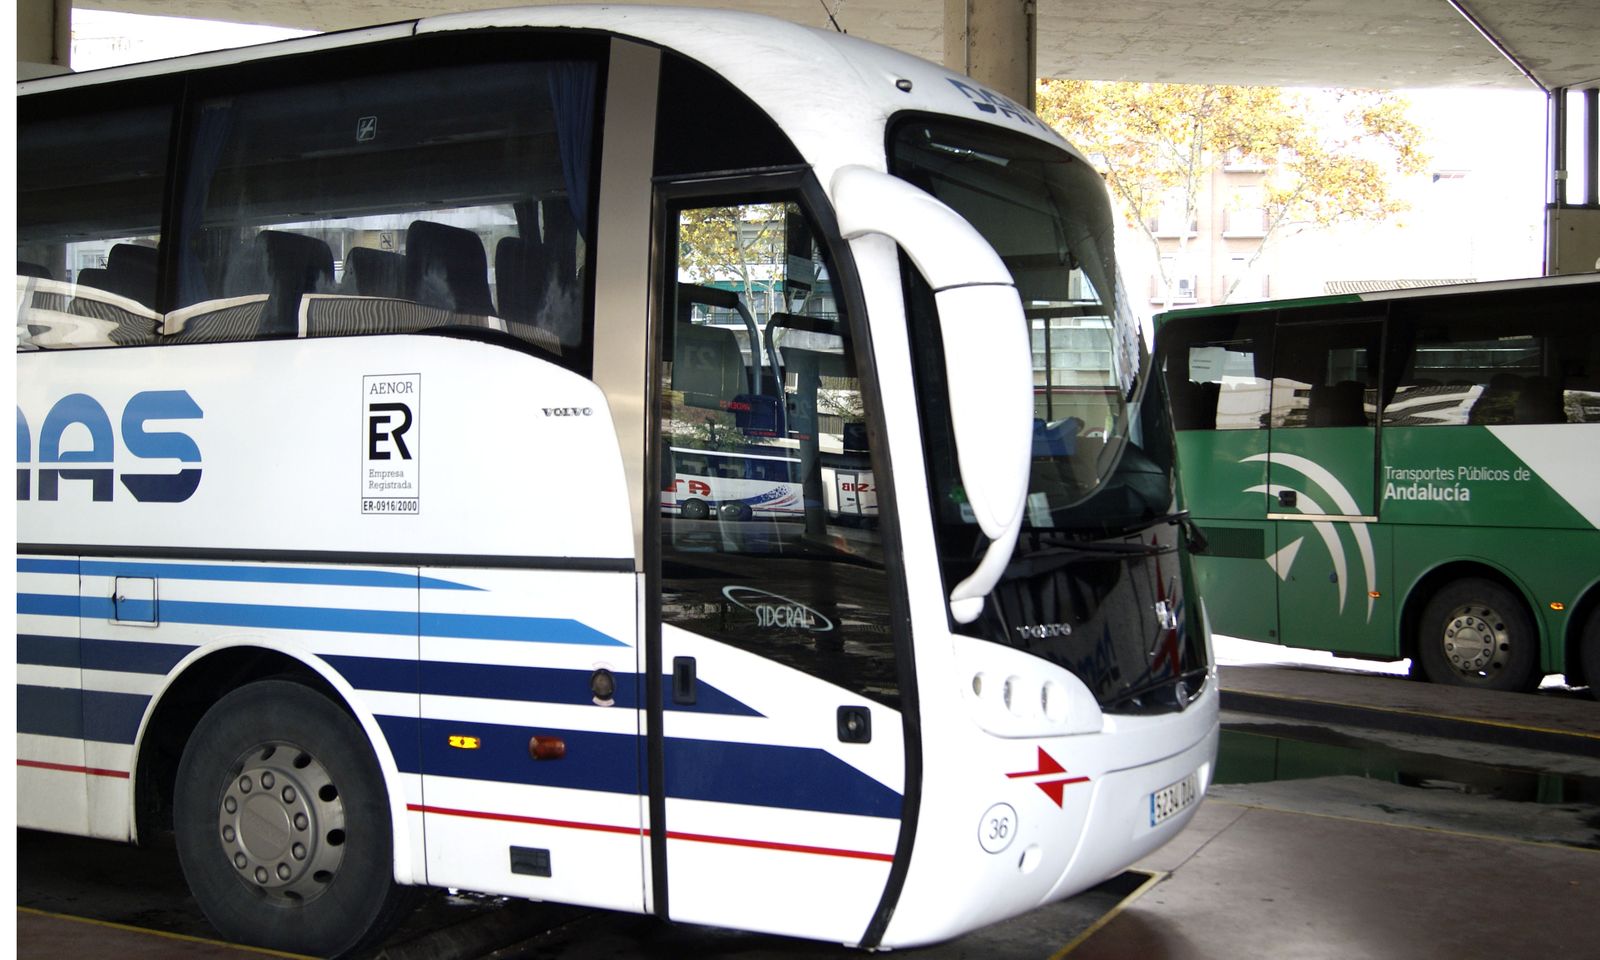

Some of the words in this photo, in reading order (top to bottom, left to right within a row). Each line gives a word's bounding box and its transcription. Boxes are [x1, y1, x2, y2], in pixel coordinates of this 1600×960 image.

[370, 381, 413, 395] AENOR
[541, 407, 593, 417] VOLVO
[369, 402, 412, 460] ER
[17, 389, 204, 503] AS
[369, 469, 404, 480] Empresa
[1384, 466, 1455, 482] Transportes
[1458, 466, 1510, 481] Públicos
[1513, 467, 1531, 481] de
[369, 480, 412, 491] Registrada
[1384, 482, 1470, 501] Andalucía
[363, 501, 417, 511] ER-0916/2000
[755, 604, 811, 629] SIDERAL
[1016, 623, 1072, 640] VOLVO
[1157, 789, 1179, 819] 5234
[989, 817, 1008, 840] 36
